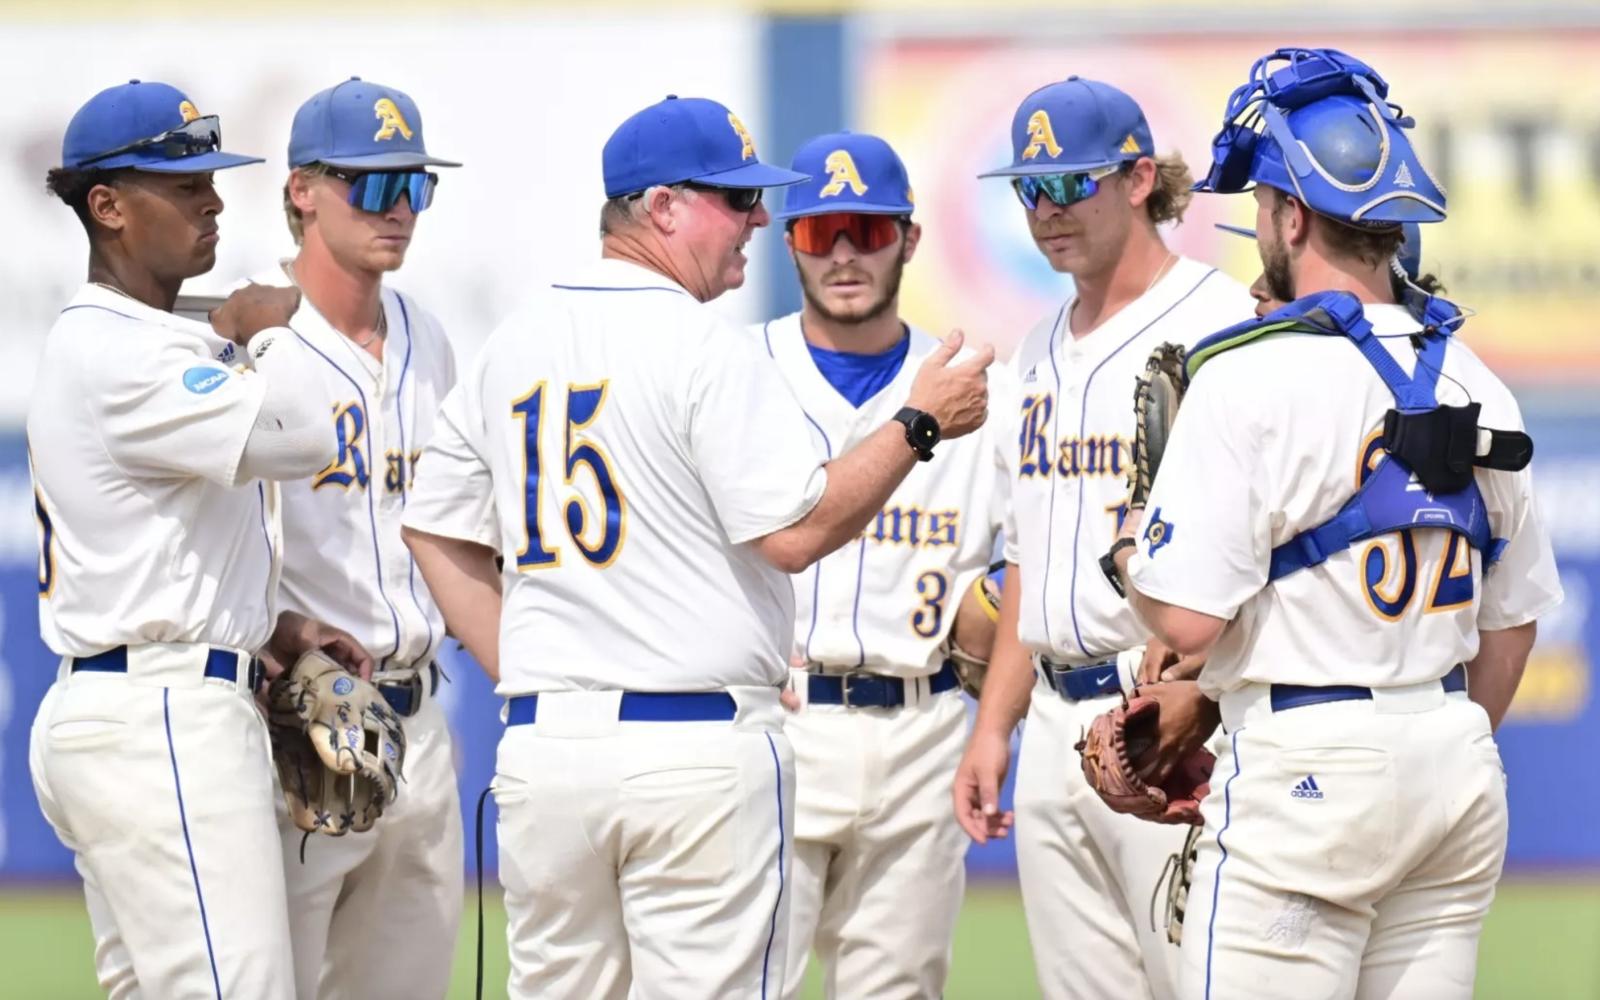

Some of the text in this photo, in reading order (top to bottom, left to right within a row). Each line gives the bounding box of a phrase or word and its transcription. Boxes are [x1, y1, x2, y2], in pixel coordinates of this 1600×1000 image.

[374, 98, 413, 142] A
[1022, 110, 1063, 161] A
[819, 149, 868, 198] A
[511, 378, 626, 571] 15
[861, 503, 960, 548] ms
[909, 568, 949, 641] 3
[1290, 789, 1324, 800] adidas
